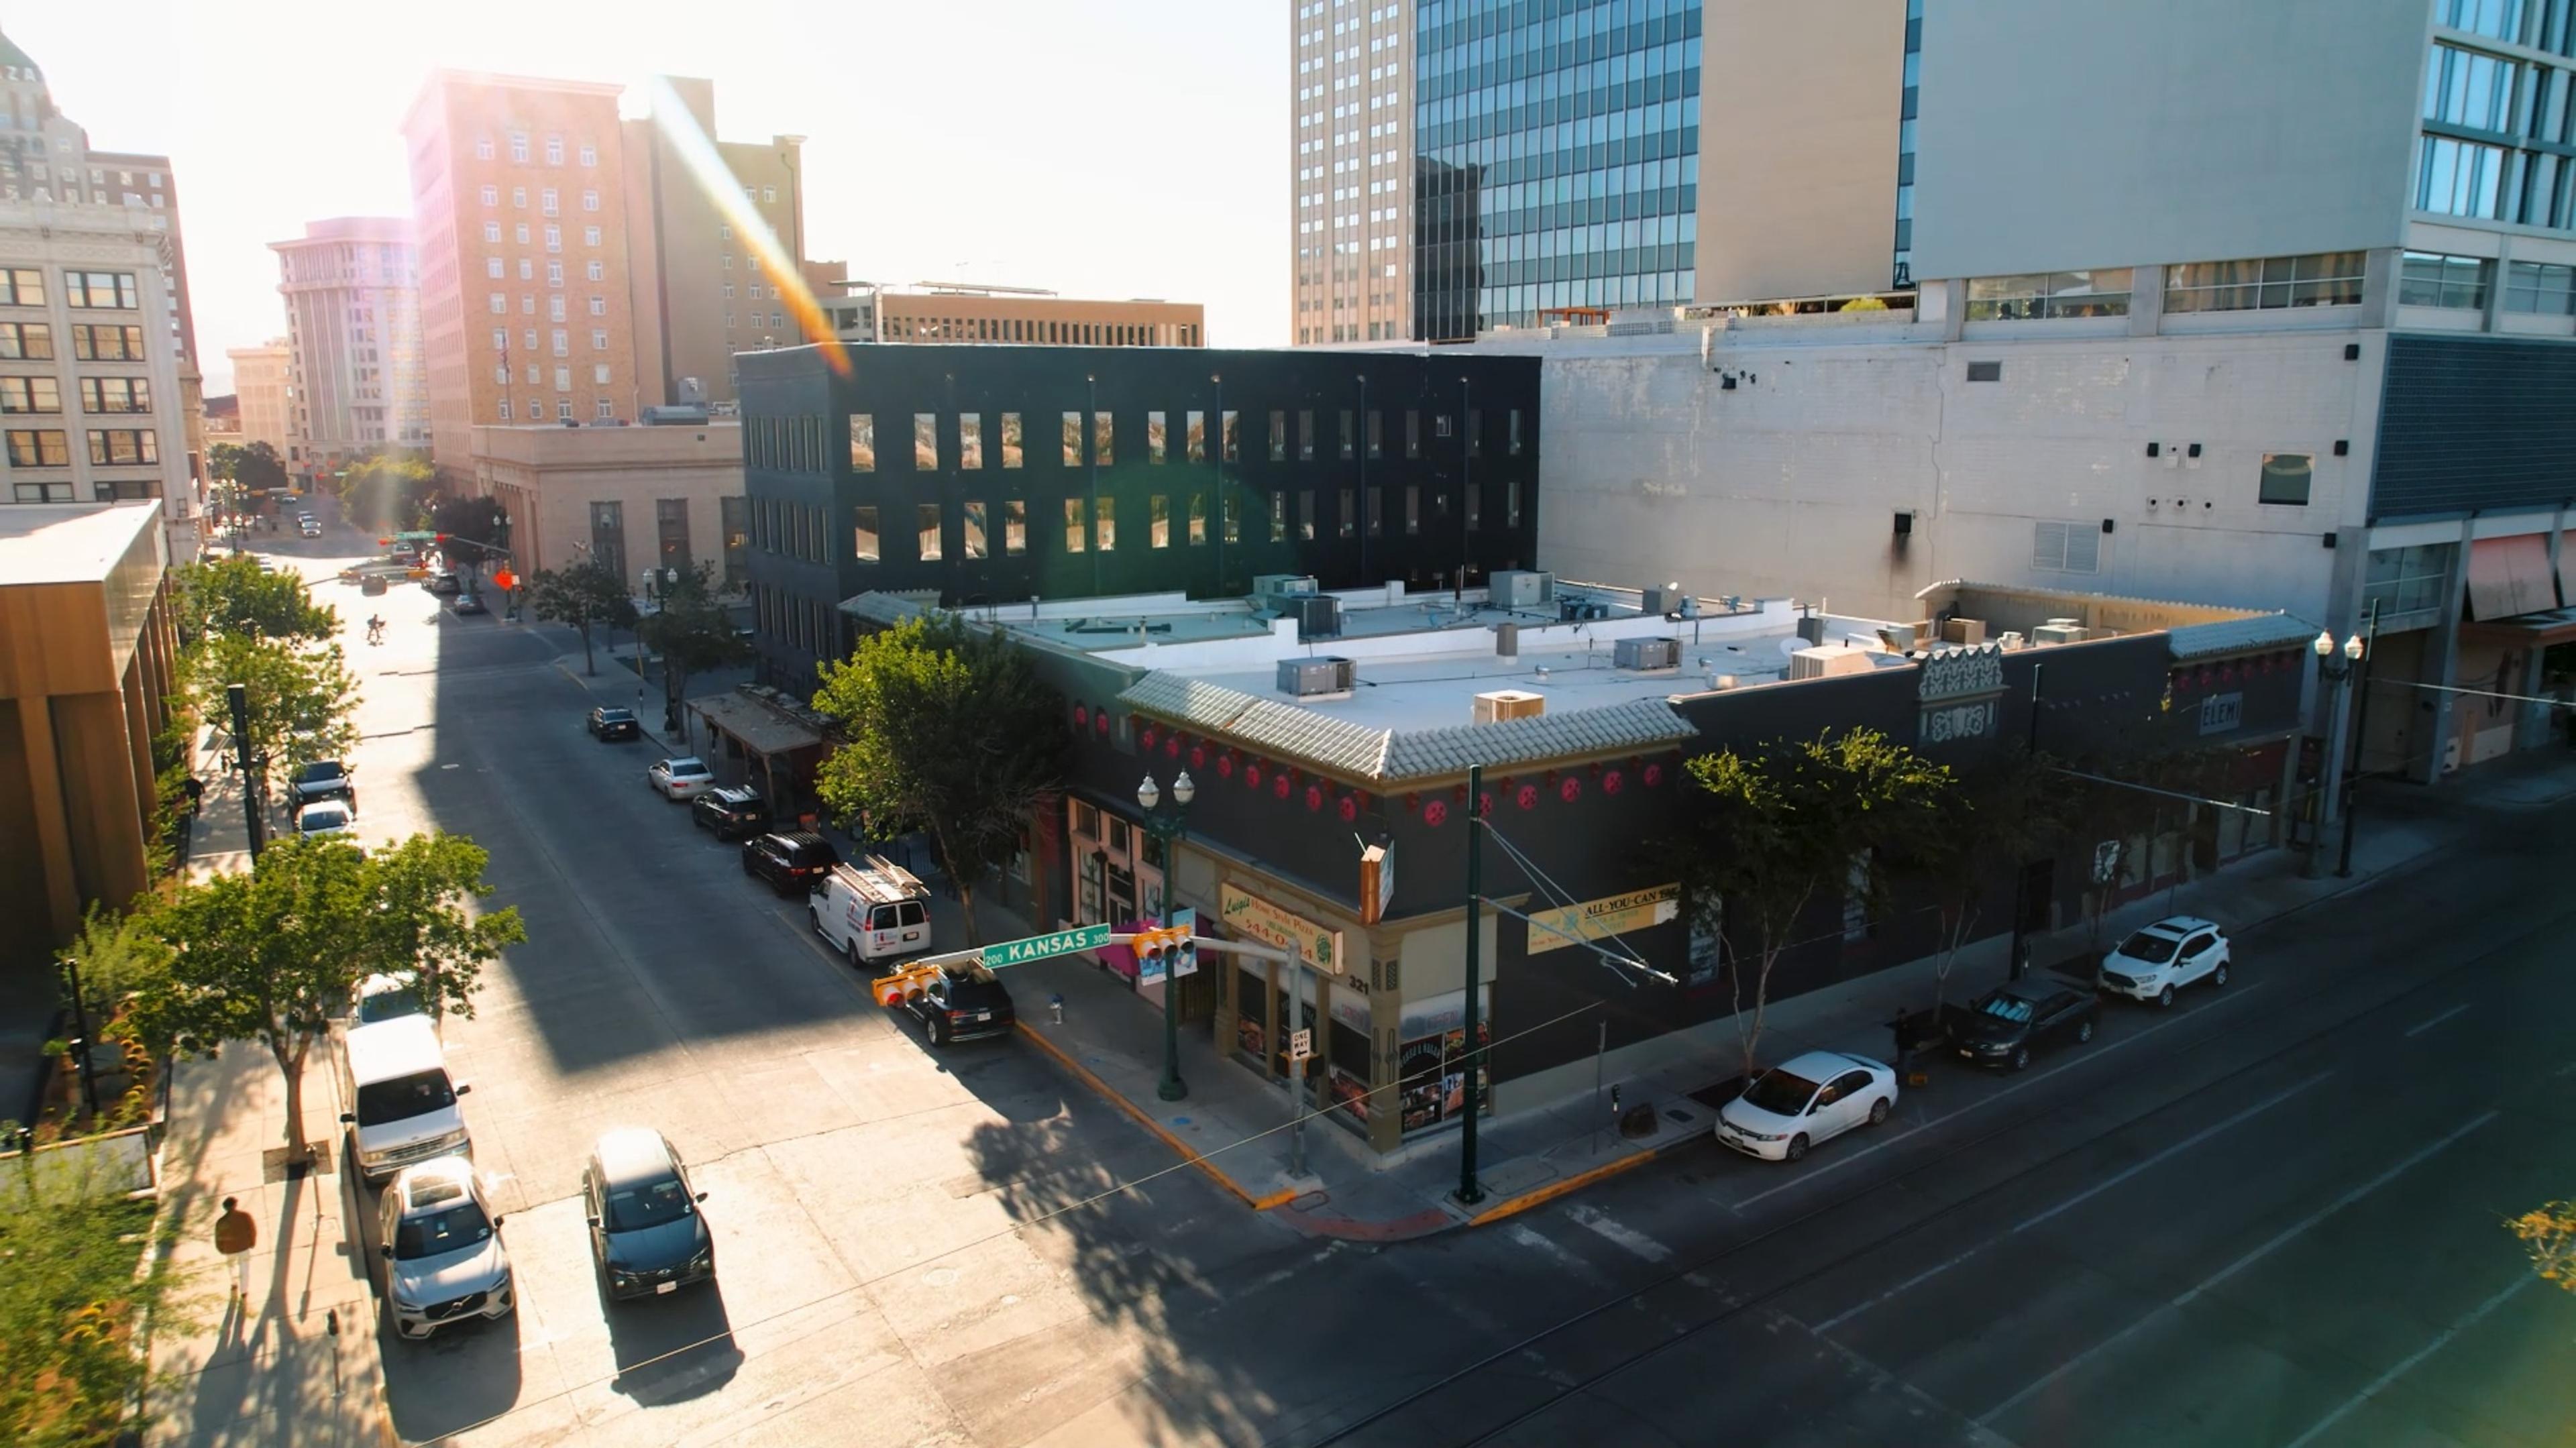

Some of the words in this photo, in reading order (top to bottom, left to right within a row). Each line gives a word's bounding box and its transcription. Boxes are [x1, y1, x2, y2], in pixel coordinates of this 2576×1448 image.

[0, 65, 37, 81] ZA
[2203, 701, 2240, 726] ELEMI
[1585, 891, 1656, 915] ALL-YOU-CAN
[986, 953, 1004, 966] 200
[1009, 932, 1087, 961] KANSAS
[1093, 933, 1109, 944] 300
[1349, 975, 1369, 995] 321
[1295, 1032, 1307, 1042] ONE
[1295, 1040, 1307, 1049] WAY
